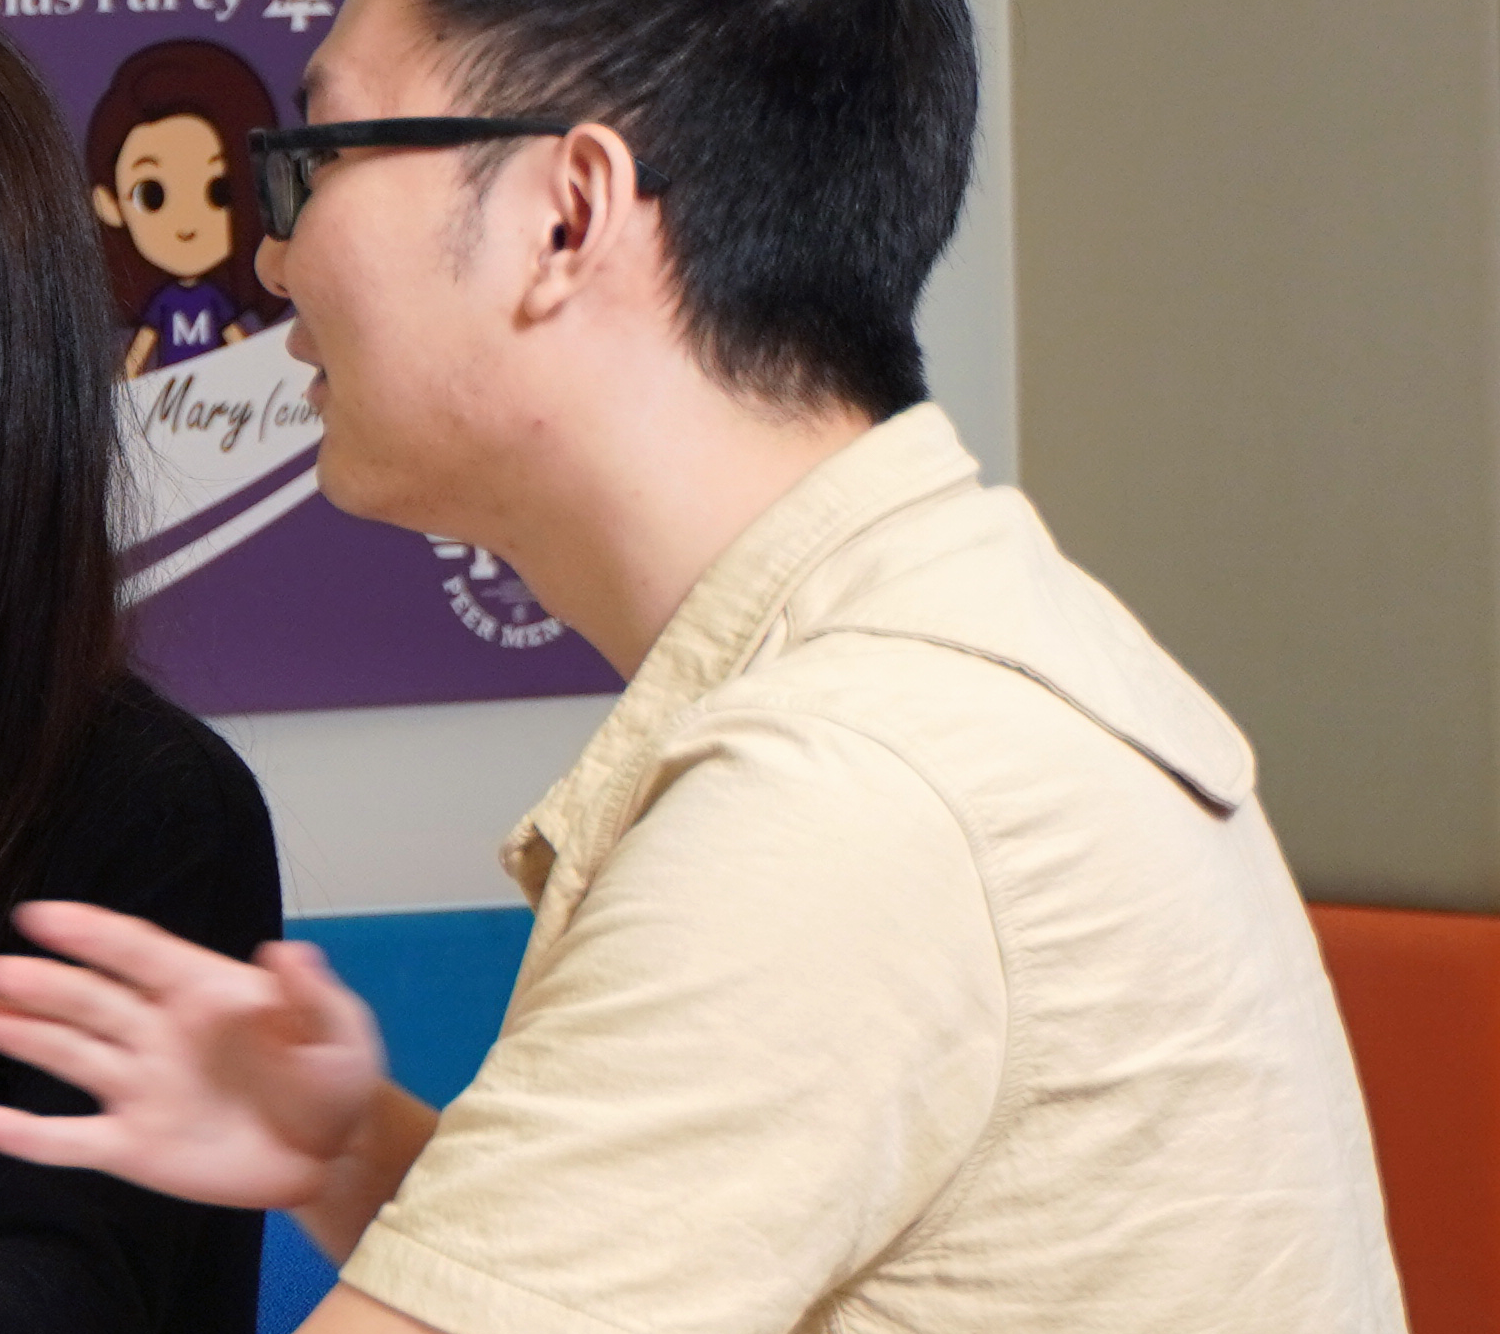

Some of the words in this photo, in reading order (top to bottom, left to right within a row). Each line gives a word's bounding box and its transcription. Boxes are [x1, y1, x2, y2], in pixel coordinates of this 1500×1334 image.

[171, 311, 211, 347] M
[144, 373, 254, 453] Mary
[258, 378, 323, 443] (civ
[442, 574, 500, 644] PEER
[500, 615, 567, 650] MEN
